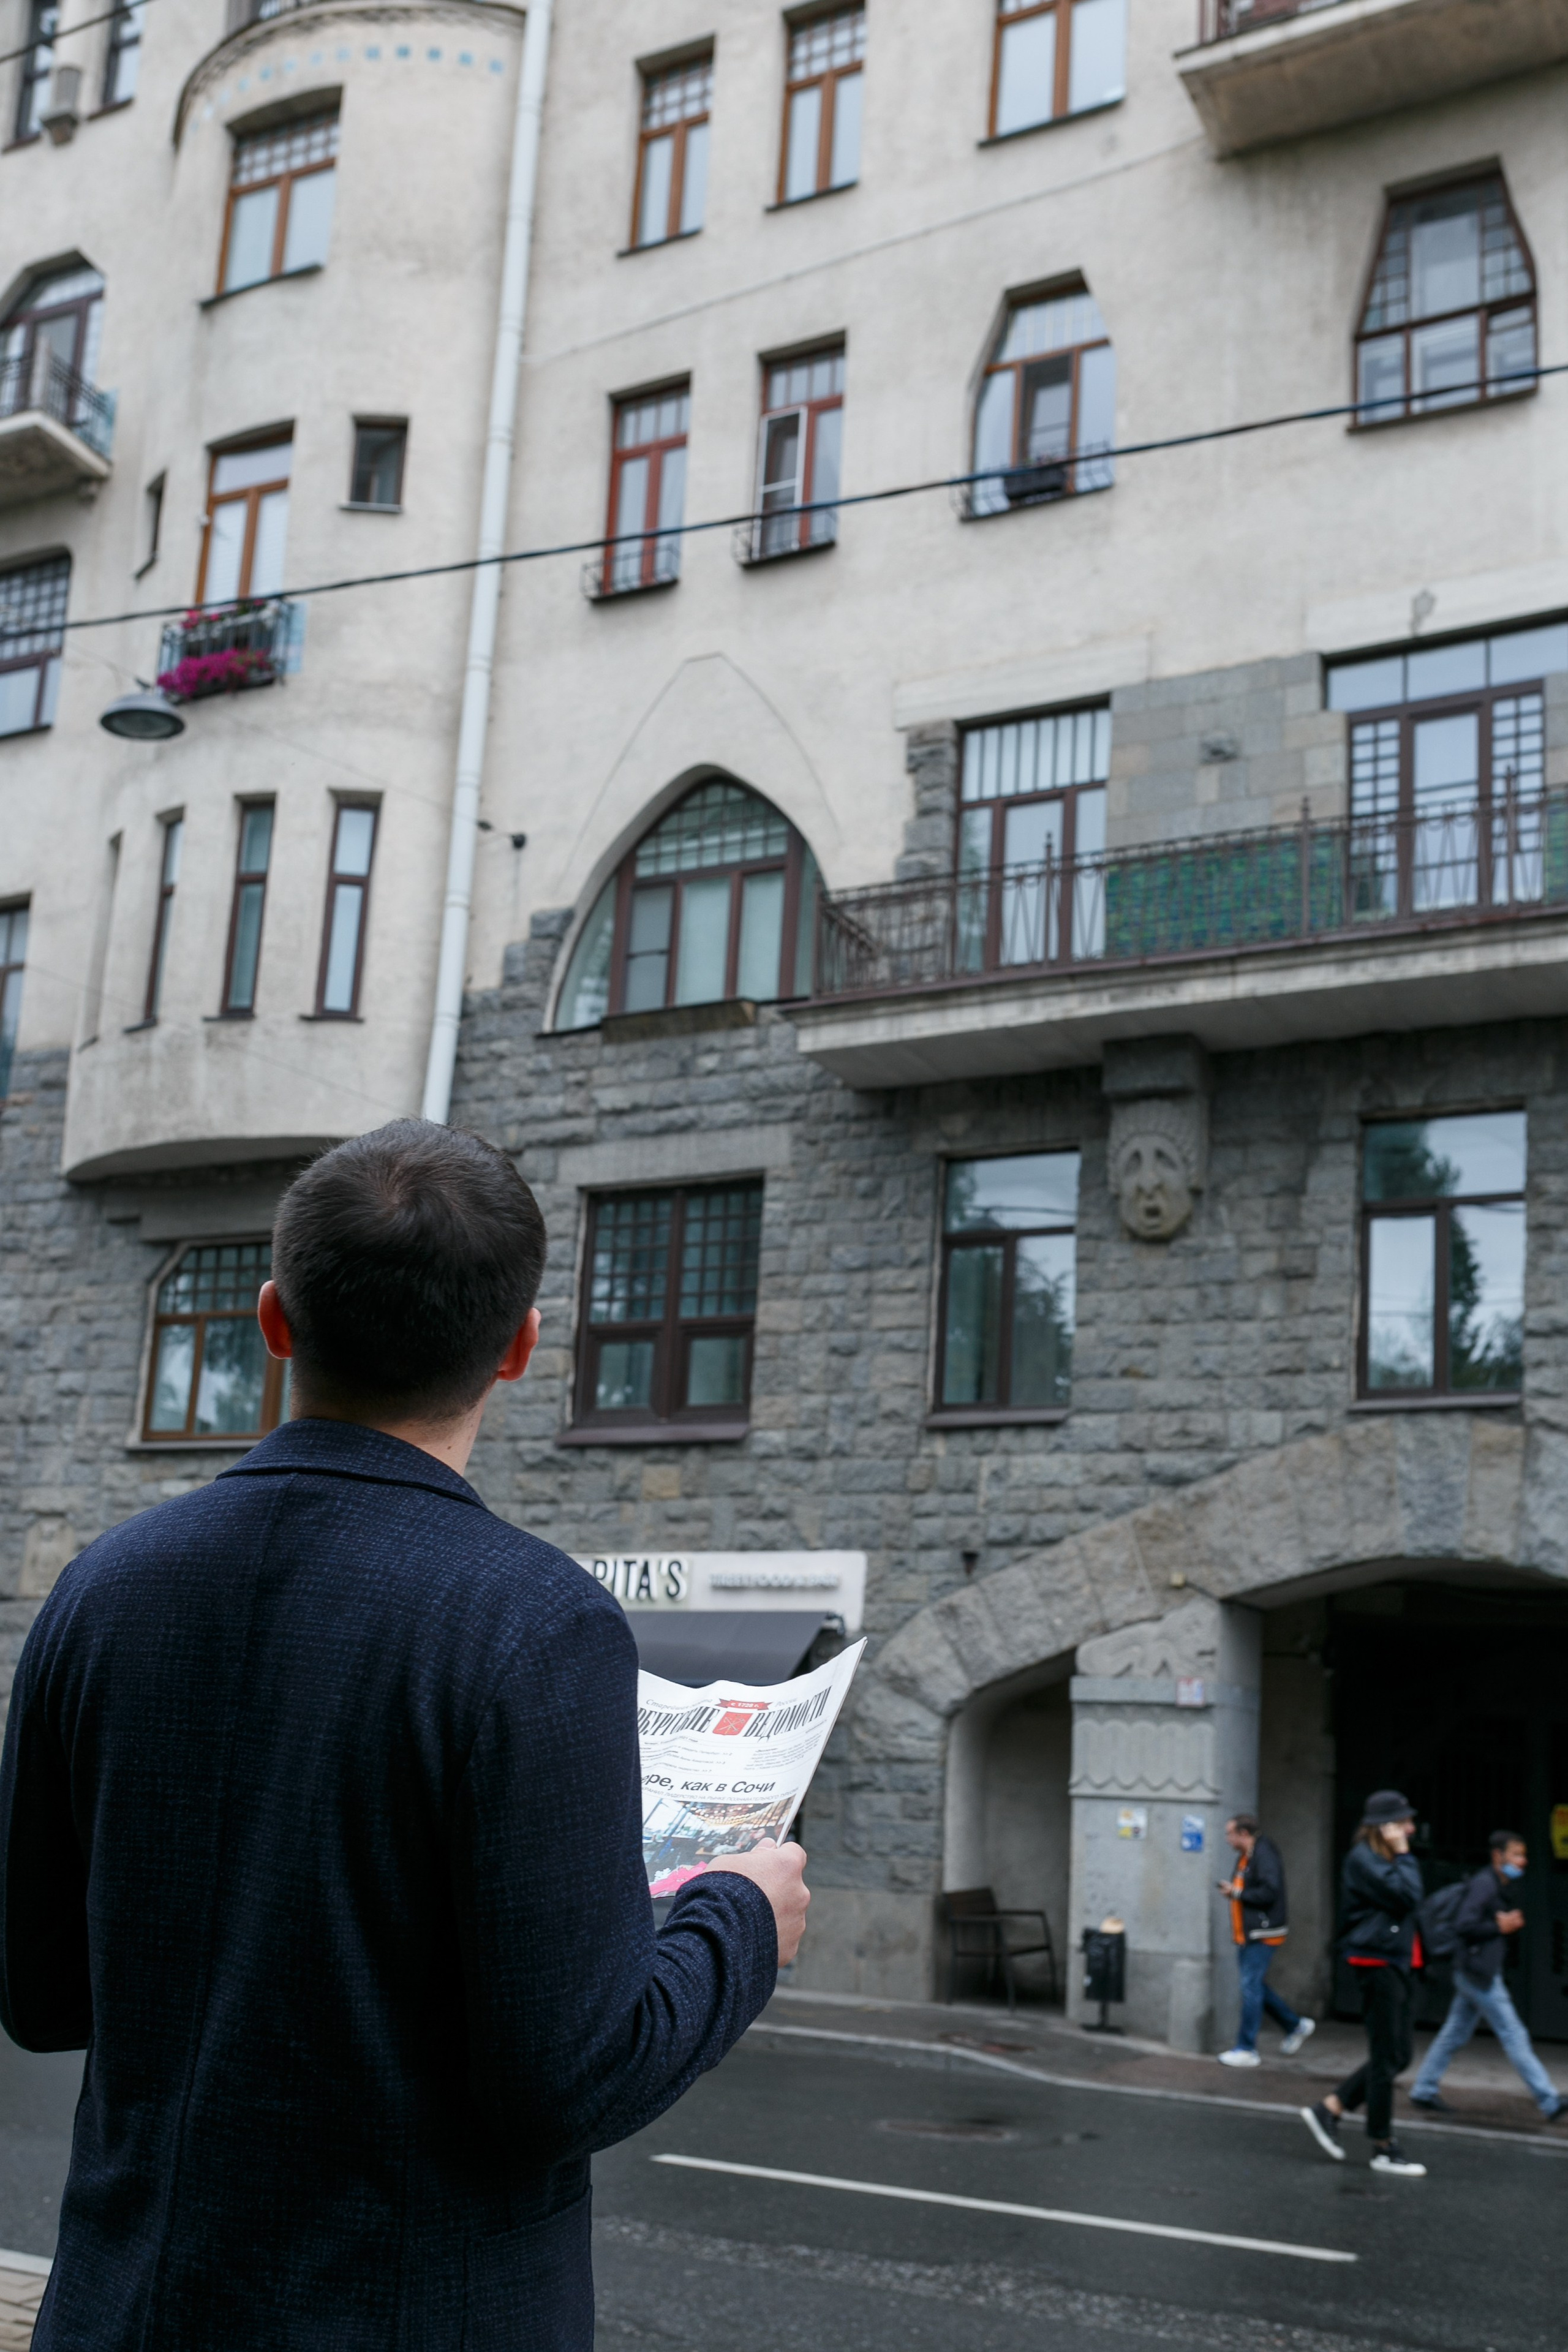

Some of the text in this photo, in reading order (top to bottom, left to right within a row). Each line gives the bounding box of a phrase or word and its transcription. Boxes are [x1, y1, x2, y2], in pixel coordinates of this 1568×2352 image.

[742, 1686, 832, 1743] ВЕДОМОСТИ
[680, 1781, 714, 1792] как
[714, 1783, 728, 1792] в
[731, 1781, 776, 1793] Сочи
